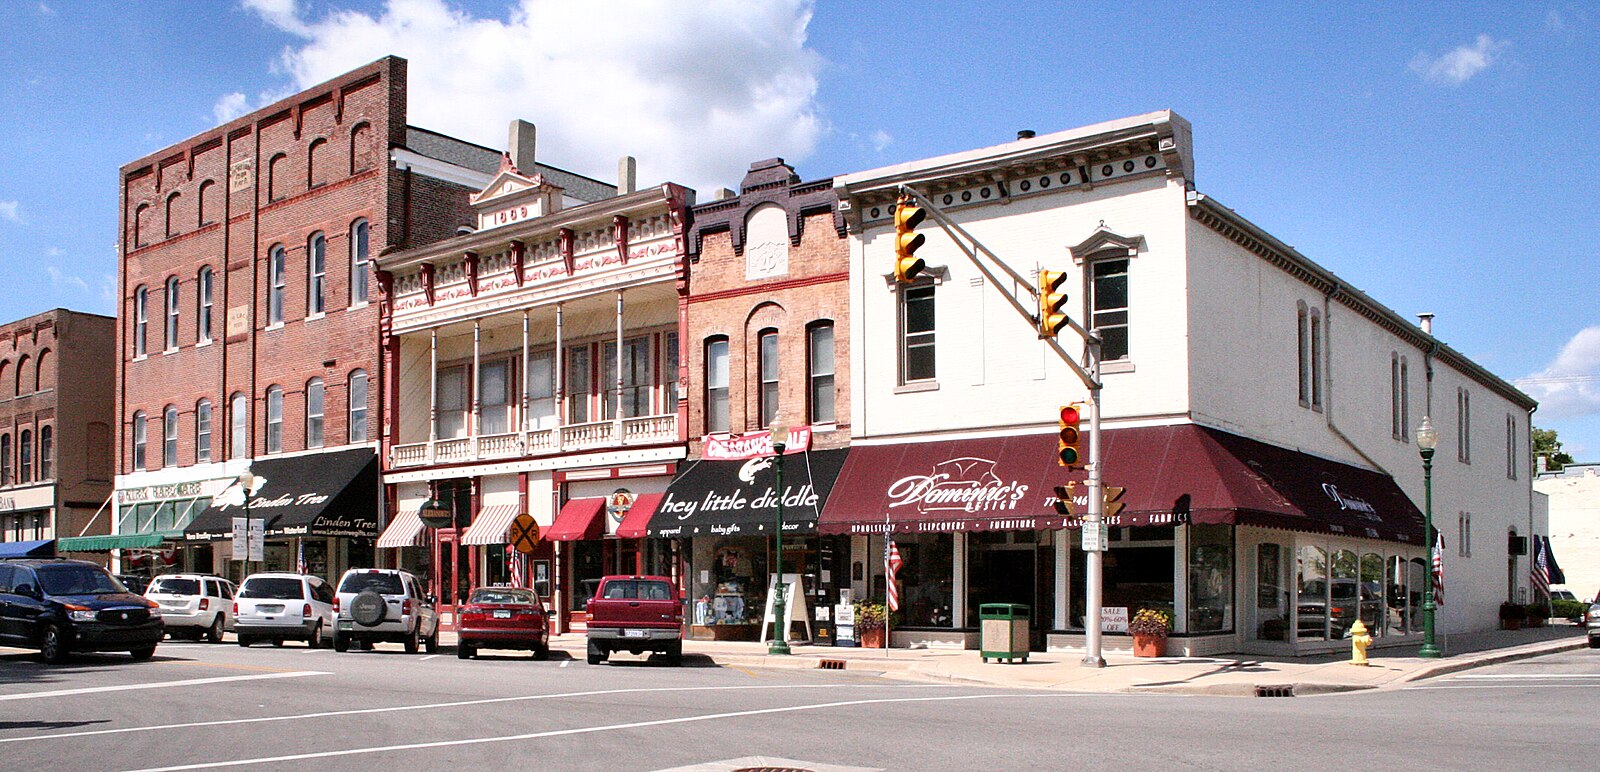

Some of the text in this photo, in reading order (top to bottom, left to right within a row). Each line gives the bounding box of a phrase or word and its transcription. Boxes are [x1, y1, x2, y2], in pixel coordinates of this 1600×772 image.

[708, 430, 808, 457] CLEARANCE ALE
[887, 473, 1029, 508] Dominic's
[242, 493, 329, 509] Linden Tree
[660, 493, 698, 520] hey
[700, 489, 747, 511] little
[751, 485, 819, 508] diddle
[965, 500, 1017, 511] DESIGN
[314, 515, 377, 528] Linden Tree
[919, 521, 965, 531] SLIPCOVERS
[990, 519, 1036, 529] FURNITURE
[1149, 513, 1188, 523] FABRICS
[512, 528, 537, 537] R R
[660, 525, 682, 537] apparel
